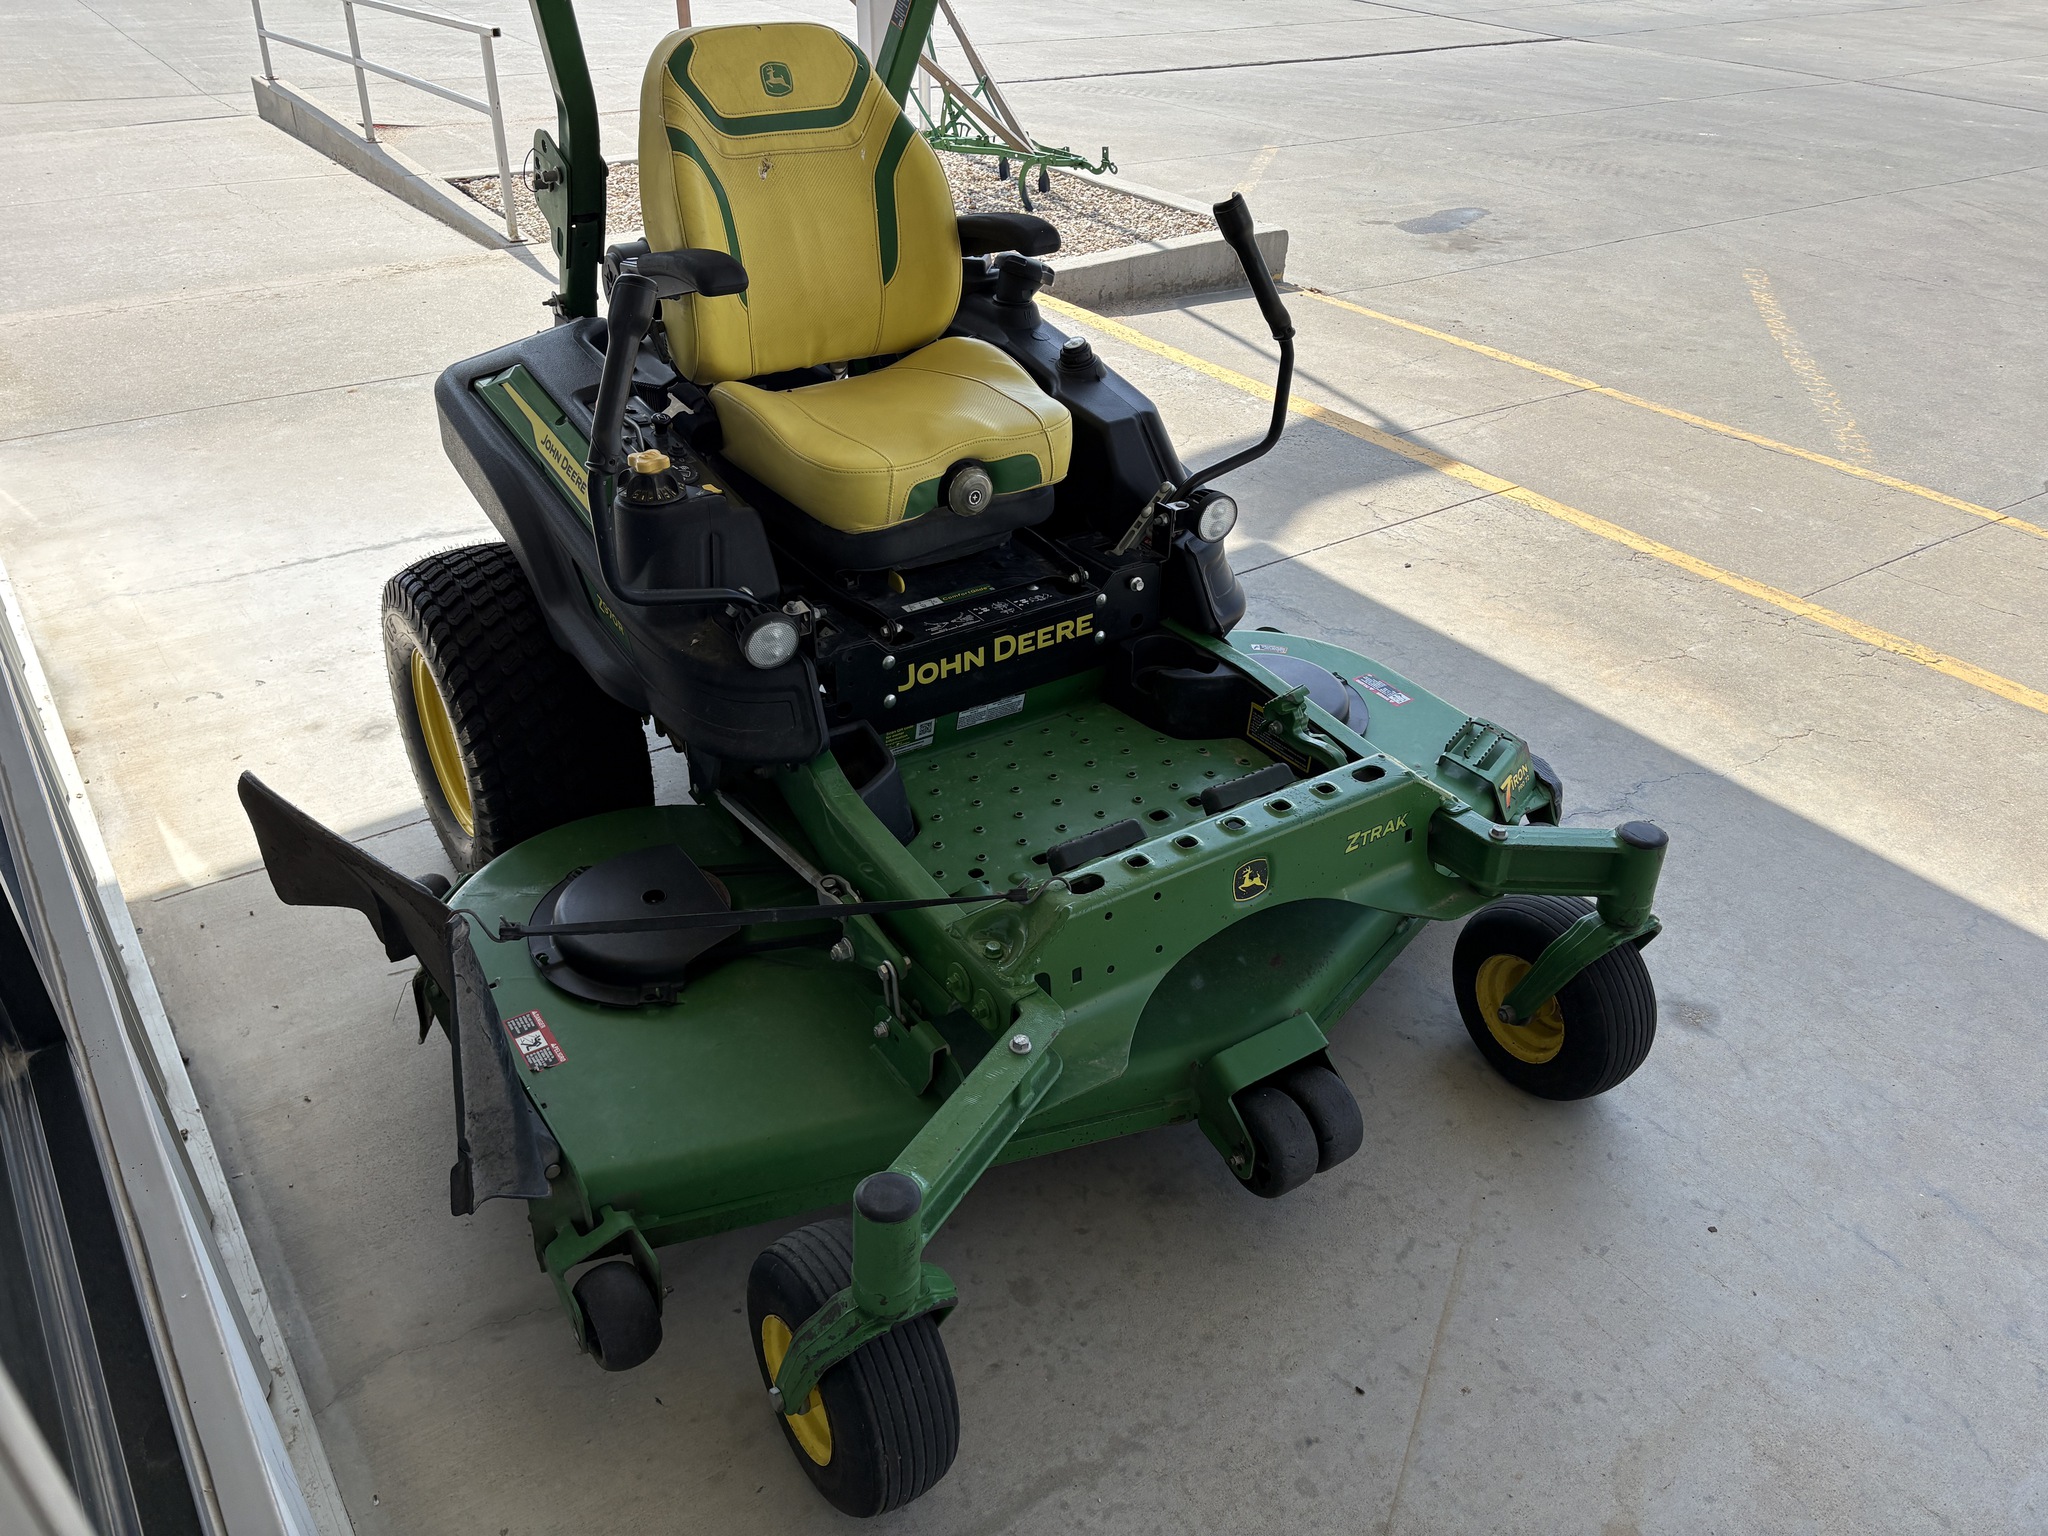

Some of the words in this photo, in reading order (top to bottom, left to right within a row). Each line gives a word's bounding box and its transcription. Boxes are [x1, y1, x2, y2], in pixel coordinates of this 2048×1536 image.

[540, 434, 562, 464] JOHN
[560, 456, 587, 494] DEERE
[897, 646, 985, 692] JOHN
[994, 613, 1094, 662] DEERE
[1344, 811, 1410, 855] ZTRAK
